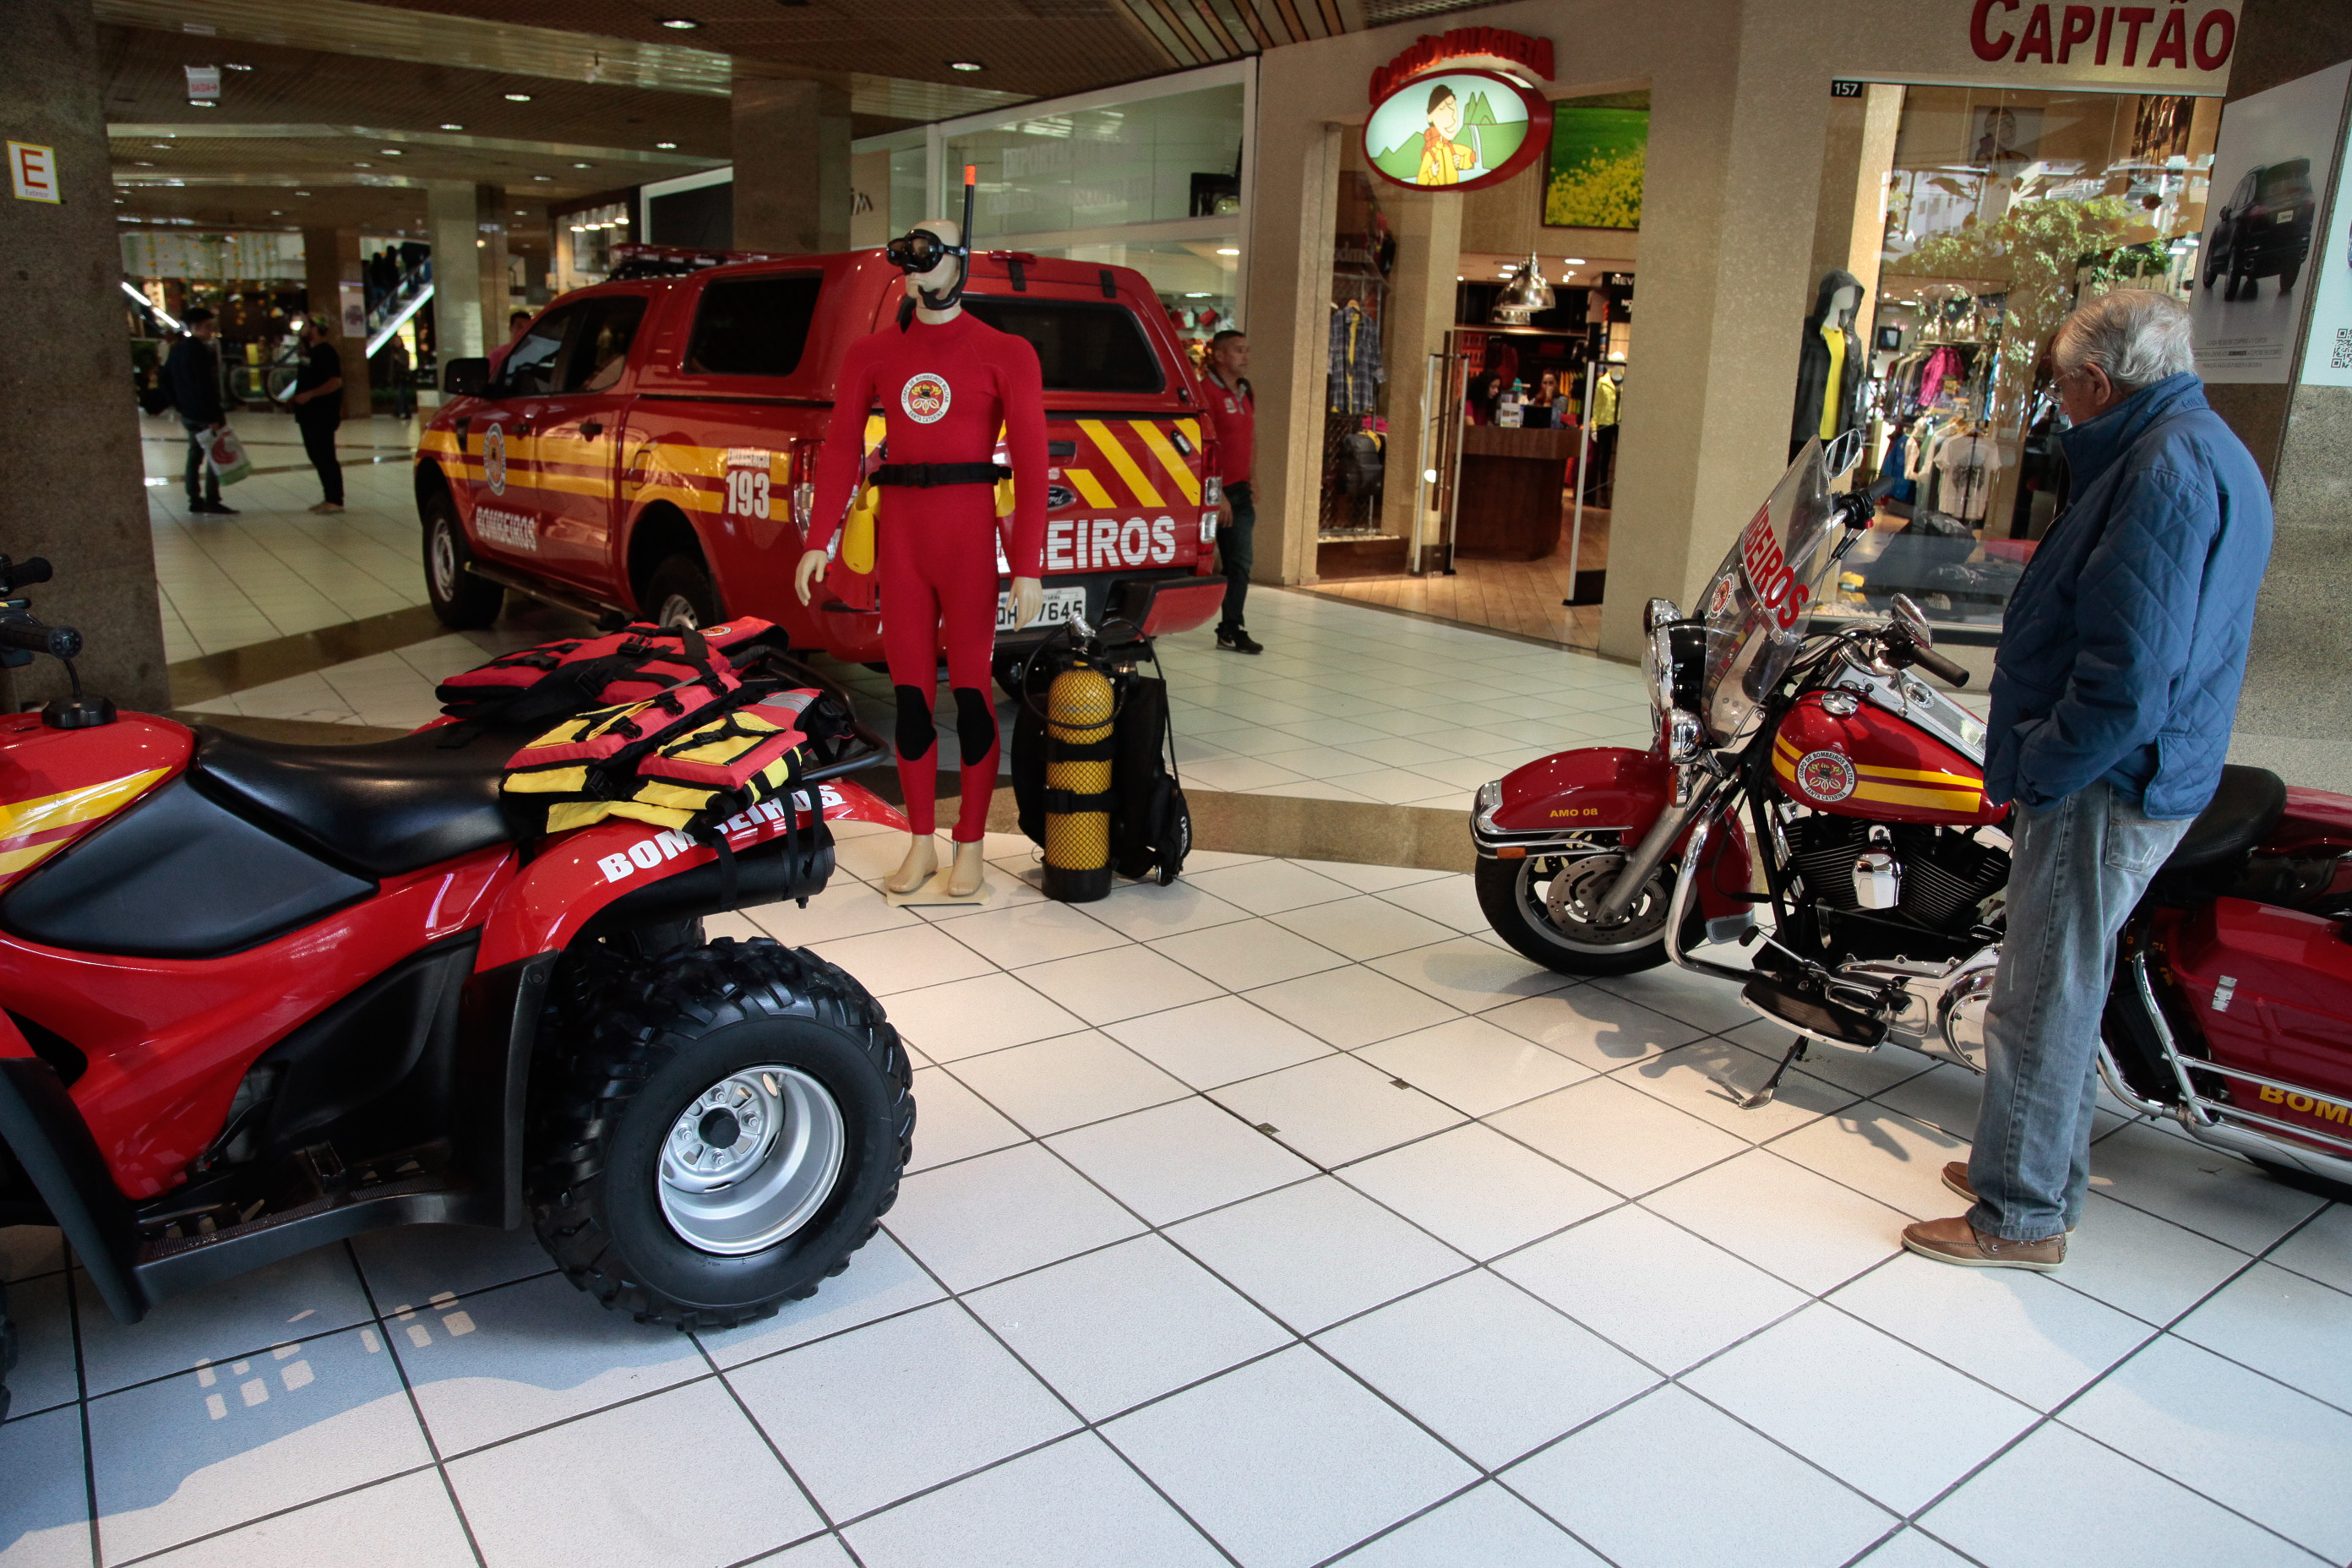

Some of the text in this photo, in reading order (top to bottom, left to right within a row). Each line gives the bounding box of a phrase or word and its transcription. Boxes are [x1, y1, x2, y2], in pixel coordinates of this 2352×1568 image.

[1970, 0, 2235, 71] CAPITÃO
[1834, 82, 1859, 95] 157
[20, 148, 48, 189] E
[25, 188, 49, 199] Extintor
[916, 374, 943, 384] BOMBEIROS
[941, 384, 950, 402] MILITAR
[908, 411, 944, 422] SANTA CATARINA
[726, 470, 770, 520] 193
[476, 507, 536, 552] BOMBEIROS
[996, 516, 1176, 574] EIROS
[1813, 752, 1846, 765] BOMBEIROS
[1843, 764, 1854, 785] MILITAR
[1805, 787, 1848, 801] SANTA CATARINA
[1549, 808, 1598, 818] AMO 08
[596, 784, 847, 884] BOMEIROS
[2259, 1085, 2352, 1126] BOM
